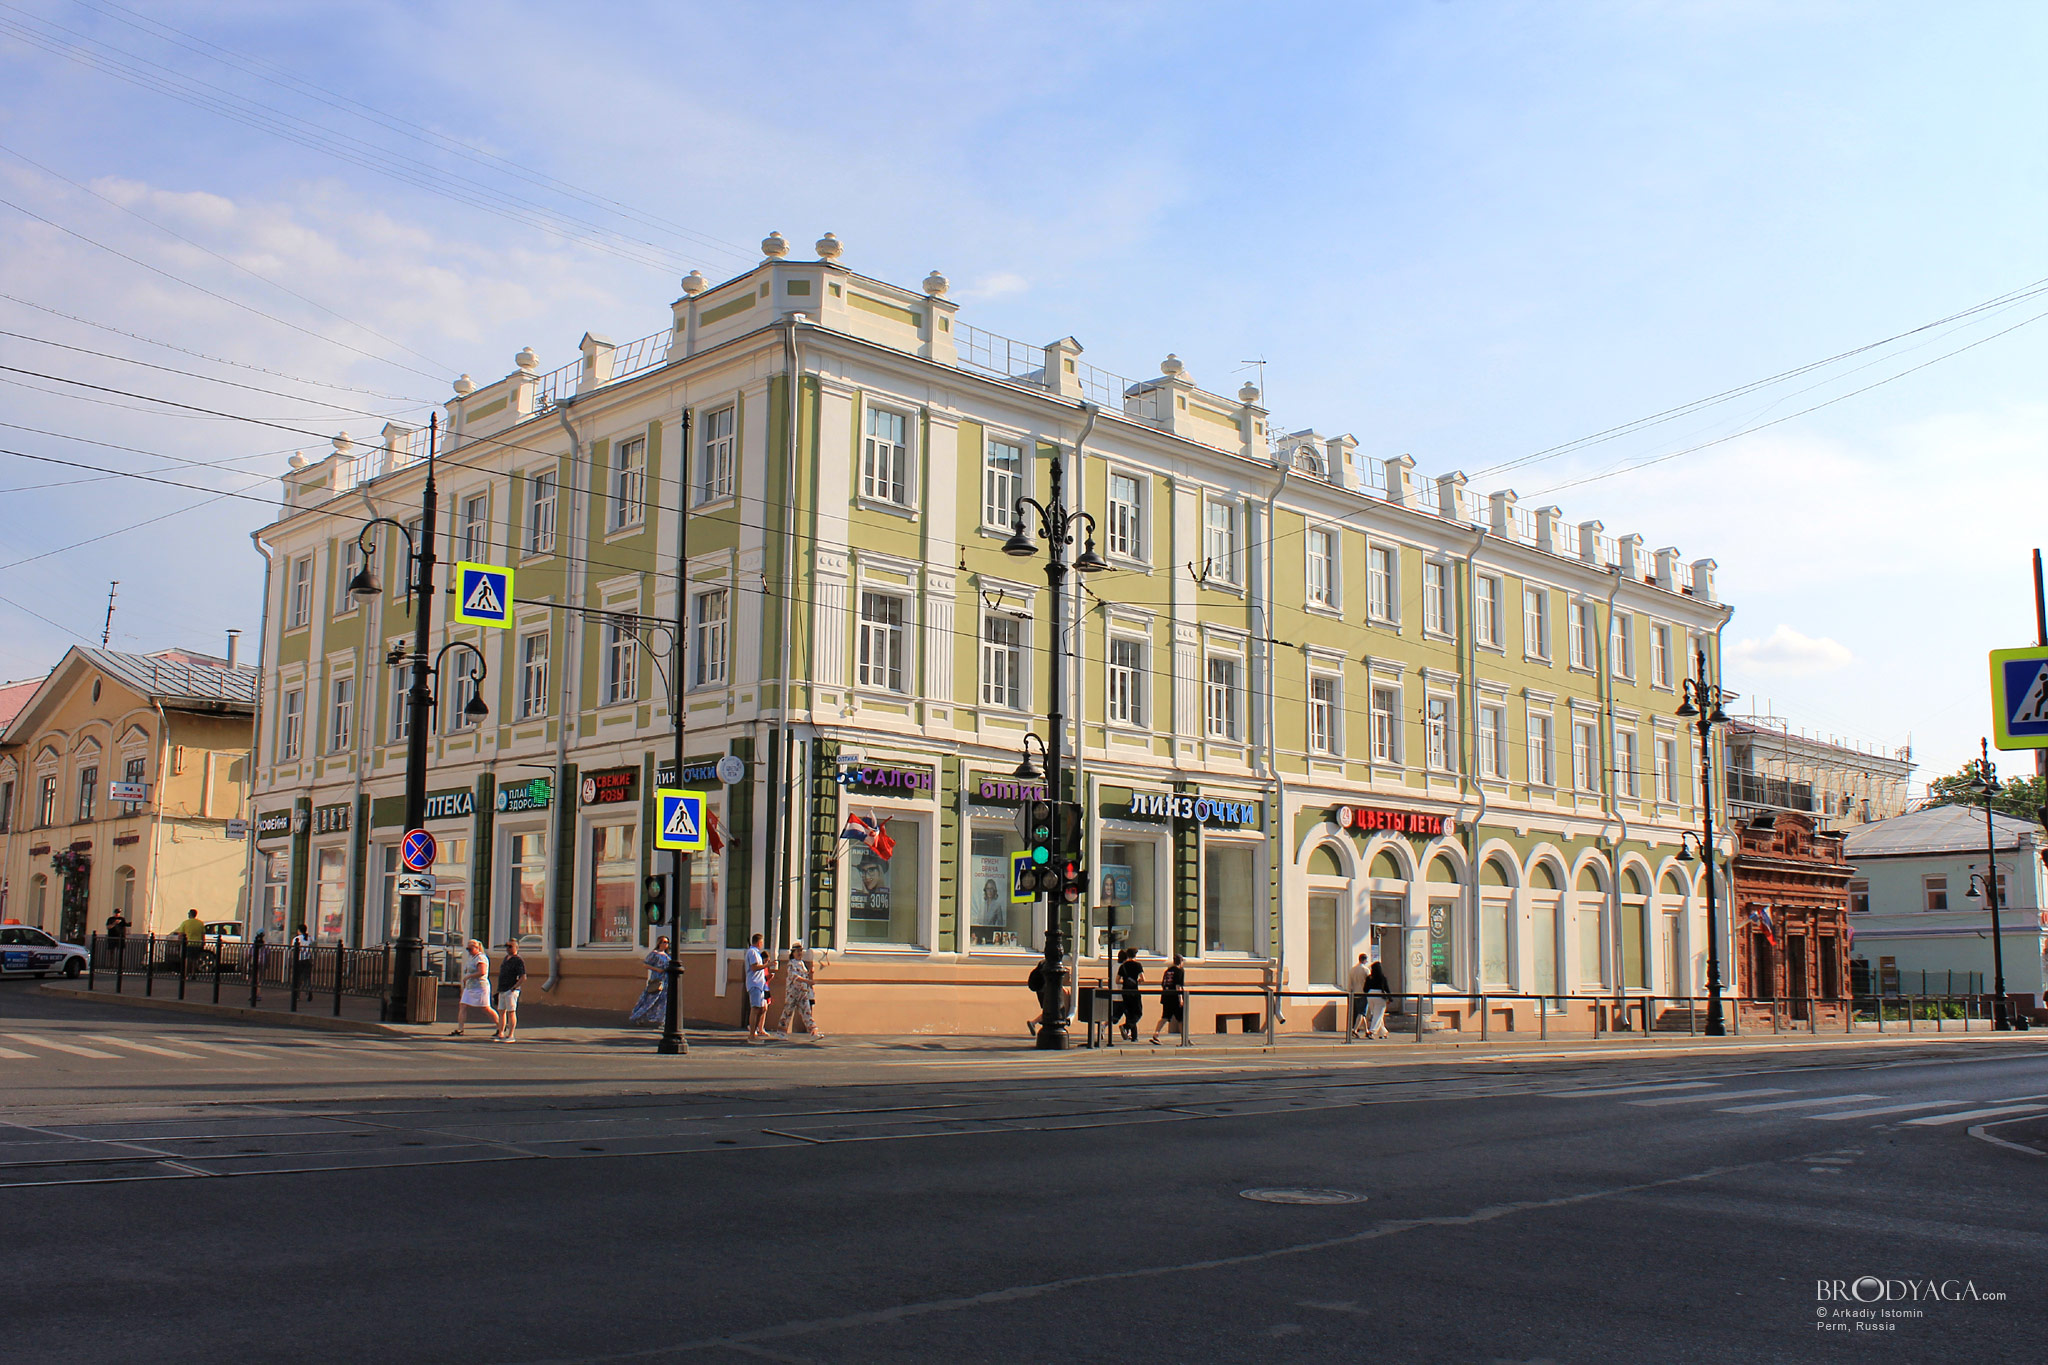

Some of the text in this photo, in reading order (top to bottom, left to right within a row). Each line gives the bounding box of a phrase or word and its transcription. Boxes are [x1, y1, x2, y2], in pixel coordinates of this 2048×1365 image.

[596, 773, 631, 788] СВЕЖИЕ
[656, 766, 716, 784] ЛИНОЧКИ
[862, 767, 932, 790] САЛОН
[585, 780, 593, 794] 24
[600, 787, 624, 802] РОЗЫ
[424, 792, 474, 817] ПТЕКА
[1131, 793, 1254, 824] ЛИНЗОЧКИ
[1357, 809, 1405, 831] ЦВЕТЫ
[1409, 814, 1441, 834] ЛЕТА
[1036, 827, 1049, 838] 44
[1116, 881, 1128, 892] 30
[870, 893, 889, 909] 30%
